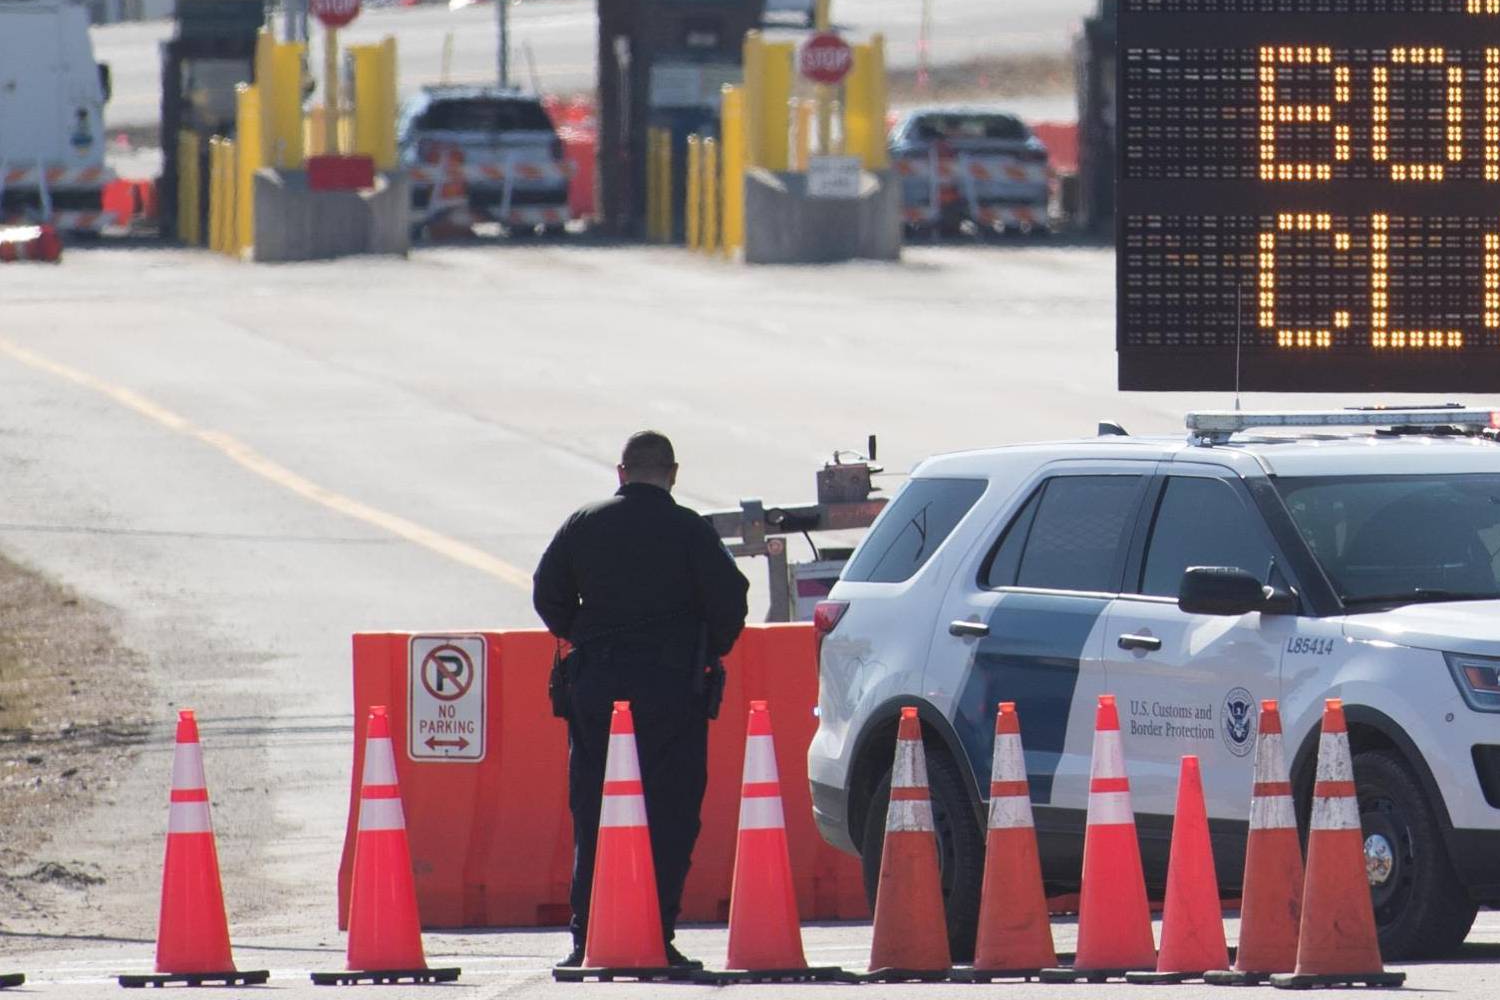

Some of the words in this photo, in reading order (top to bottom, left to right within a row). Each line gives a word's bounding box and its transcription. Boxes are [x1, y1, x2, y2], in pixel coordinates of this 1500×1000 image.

[438, 704, 456, 719] NO
[1129, 700, 1150, 716] U.S.
[1152, 701, 1193, 719] Customs
[1194, 703, 1212, 720] and
[419, 720, 475, 734] PARKING
[1130, 719, 1163, 737] Border
[1165, 722, 1215, 740] Protection
